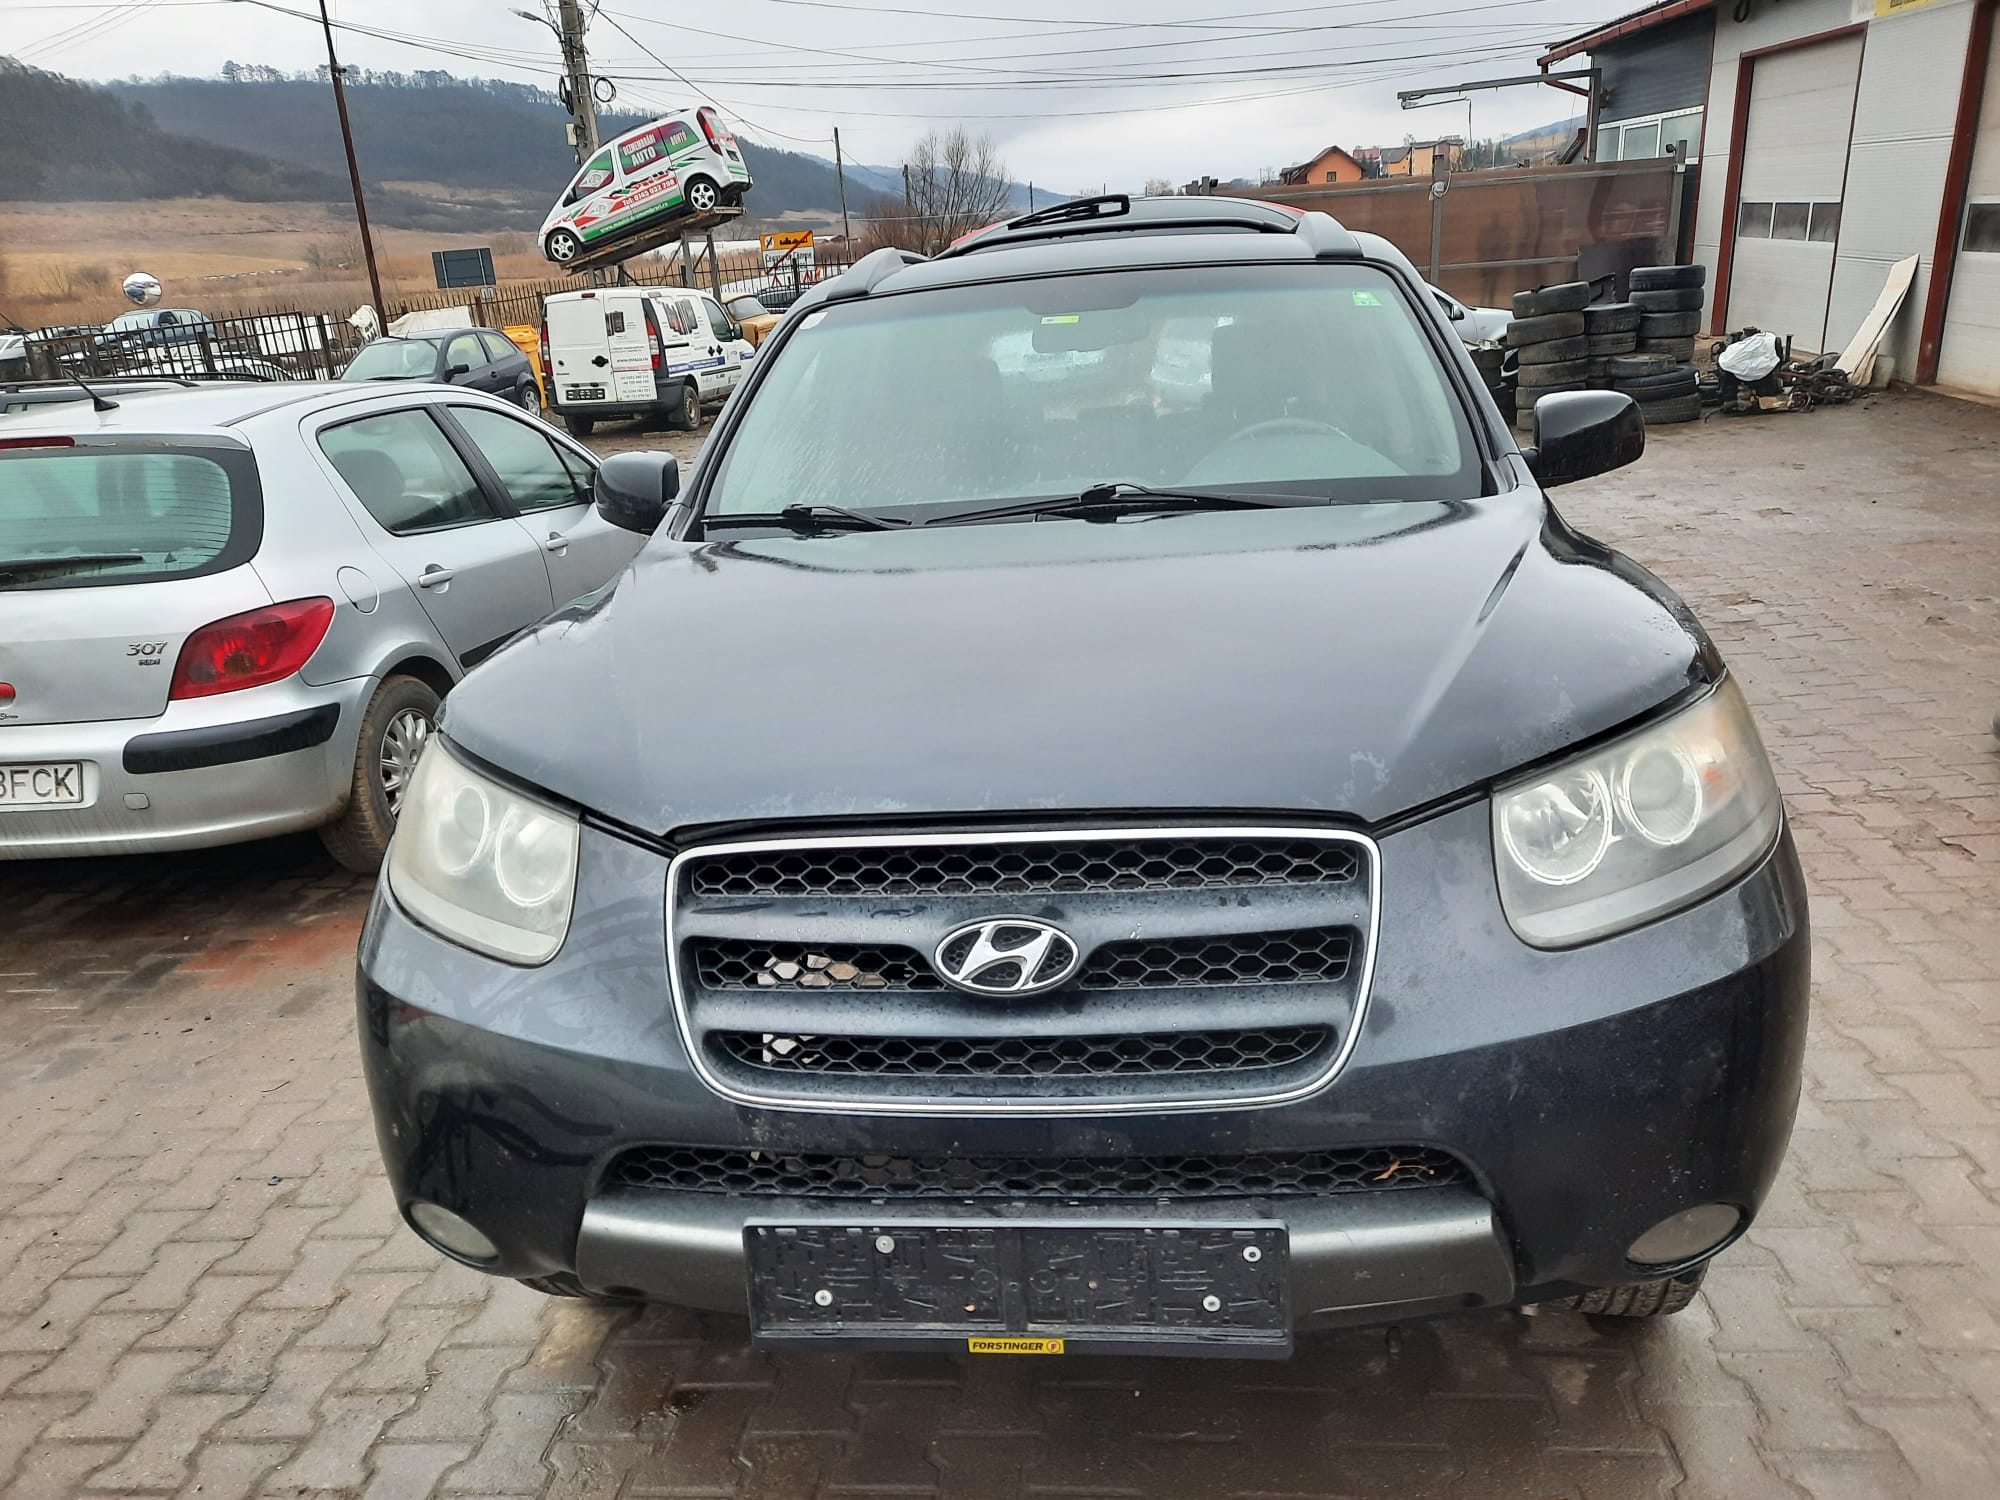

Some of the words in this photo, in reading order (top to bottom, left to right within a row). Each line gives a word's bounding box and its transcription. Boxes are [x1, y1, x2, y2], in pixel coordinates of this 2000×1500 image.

[631, 146, 656, 167] AUTO
[127, 641, 168, 656] 307
[973, 1342, 1044, 1351] FORSTINGER
